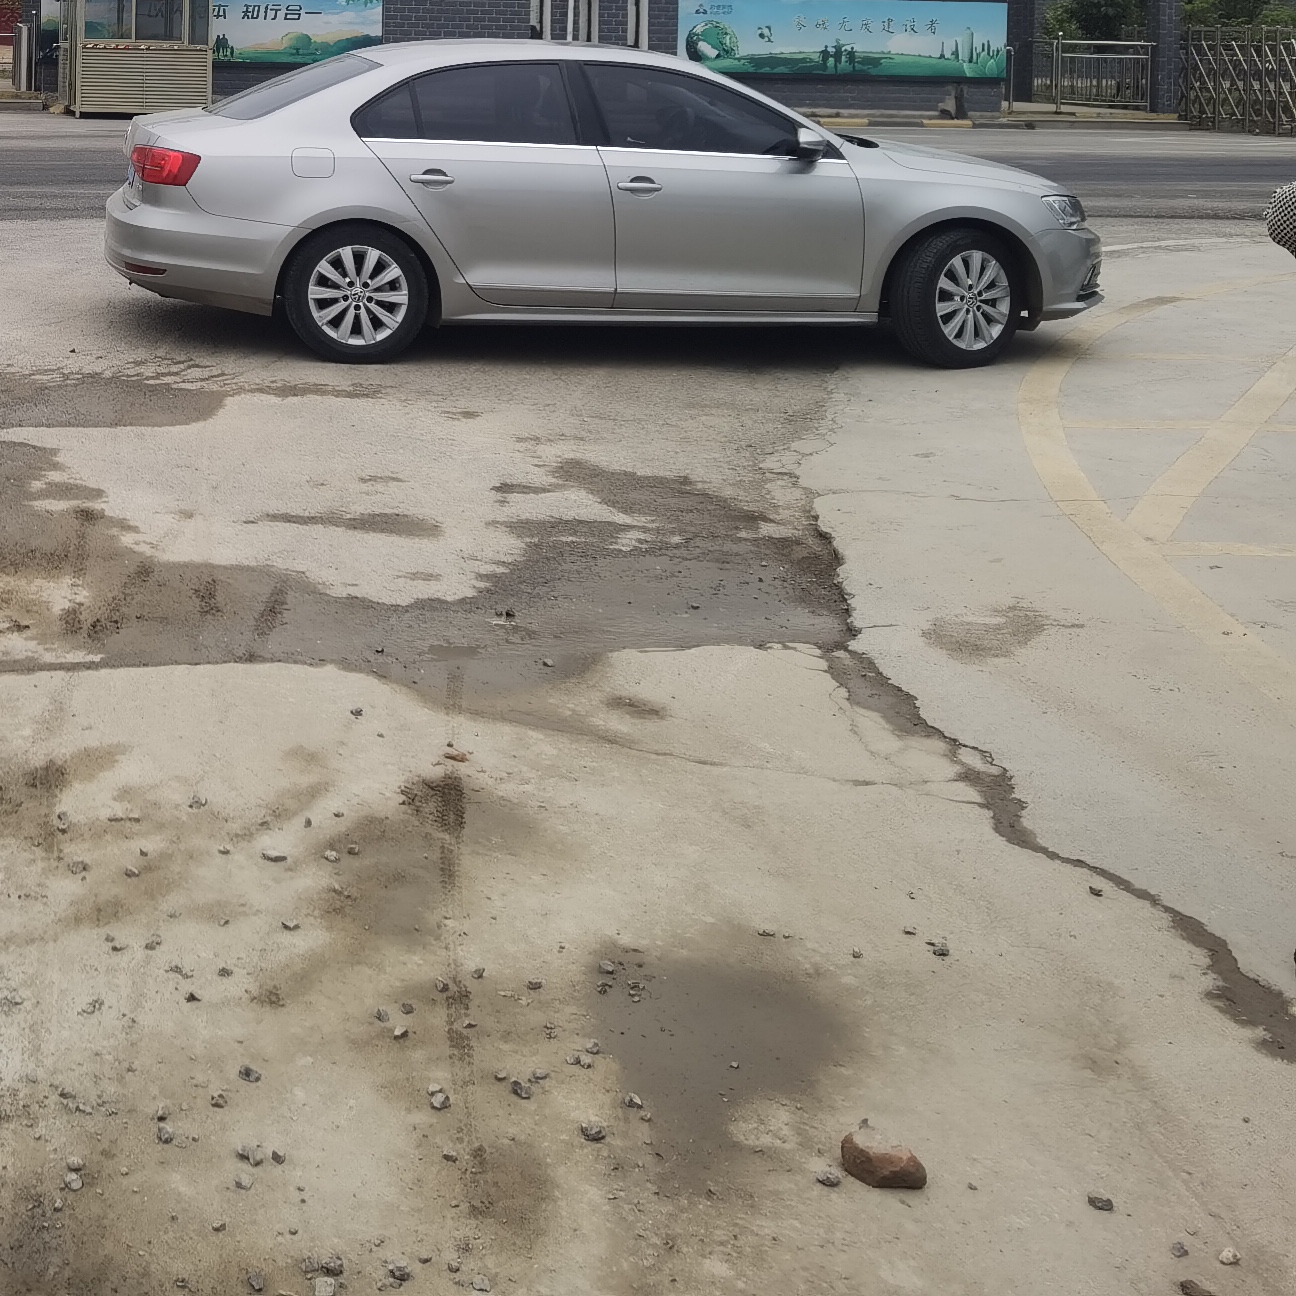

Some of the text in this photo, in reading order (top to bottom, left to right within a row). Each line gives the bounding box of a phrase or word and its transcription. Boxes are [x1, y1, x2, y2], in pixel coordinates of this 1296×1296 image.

[241, 3, 323, 21] 知行合一
[793, 15, 940, 35] 零碳无废建设者
